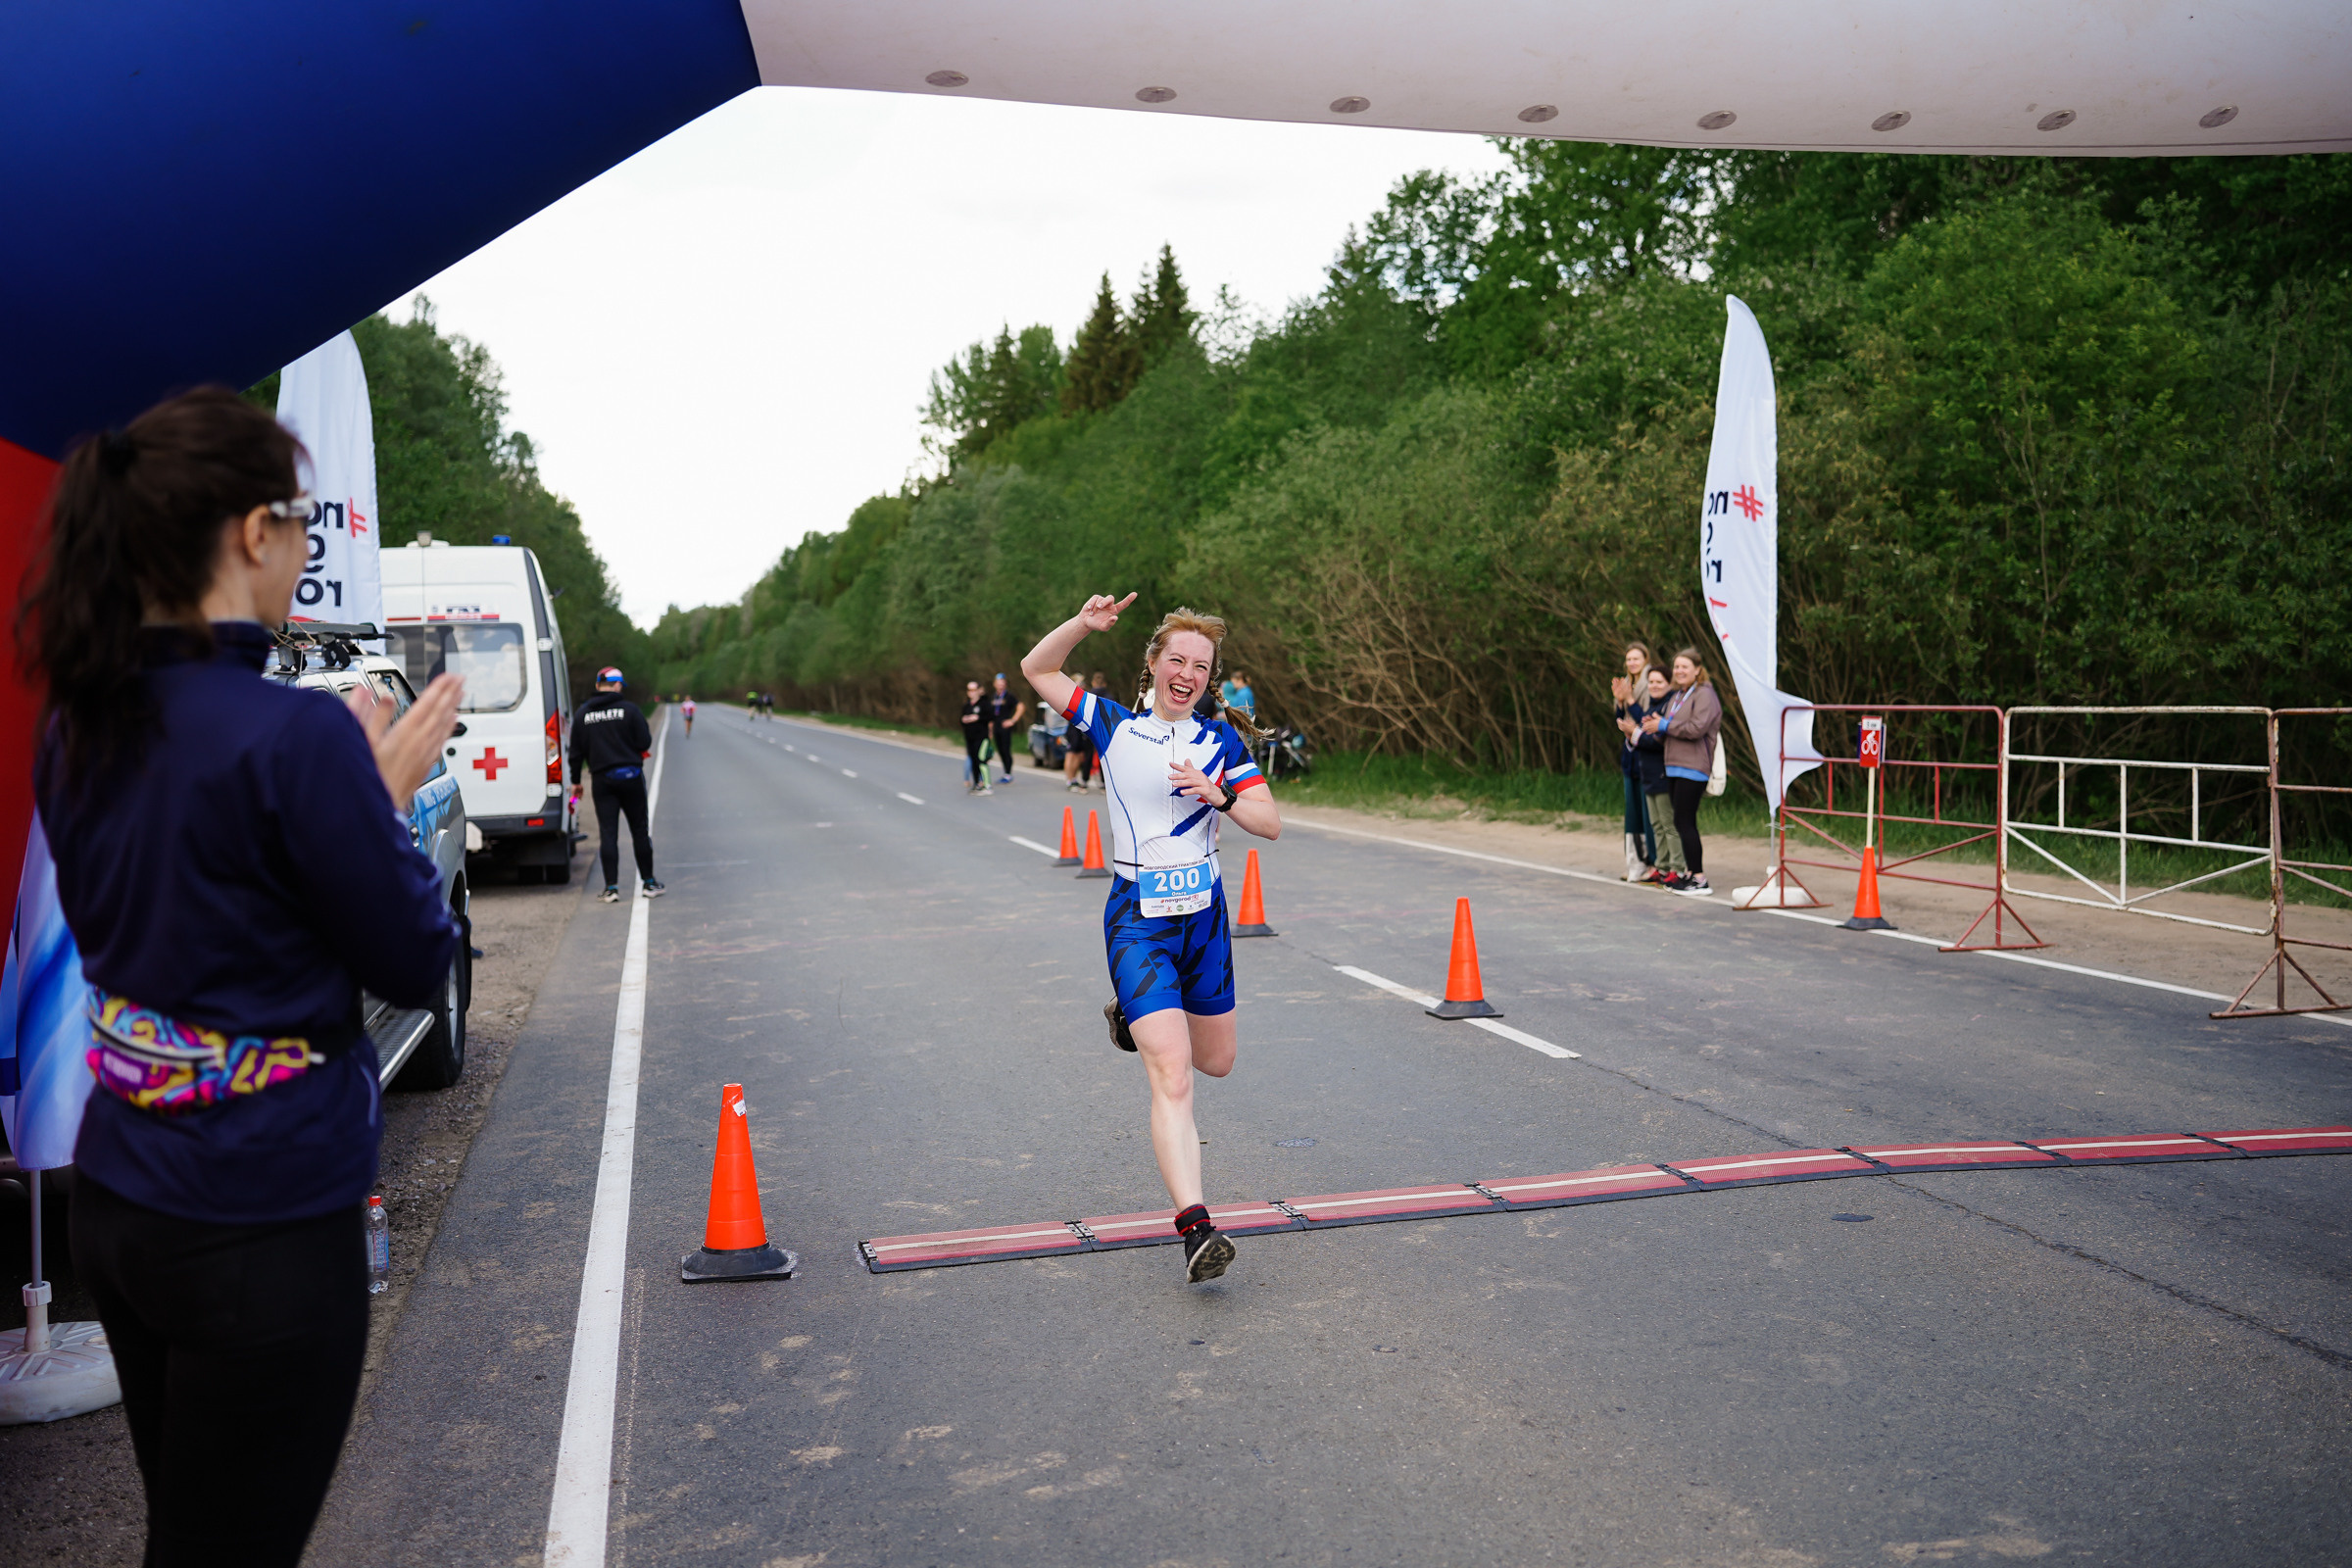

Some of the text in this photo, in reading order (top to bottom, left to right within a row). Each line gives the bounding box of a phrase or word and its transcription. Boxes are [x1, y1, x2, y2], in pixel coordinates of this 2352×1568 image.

[584, 709, 624, 724] ATHLETE
[1128, 726, 1164, 745] Severstal
[1153, 867, 1200, 892] 200
